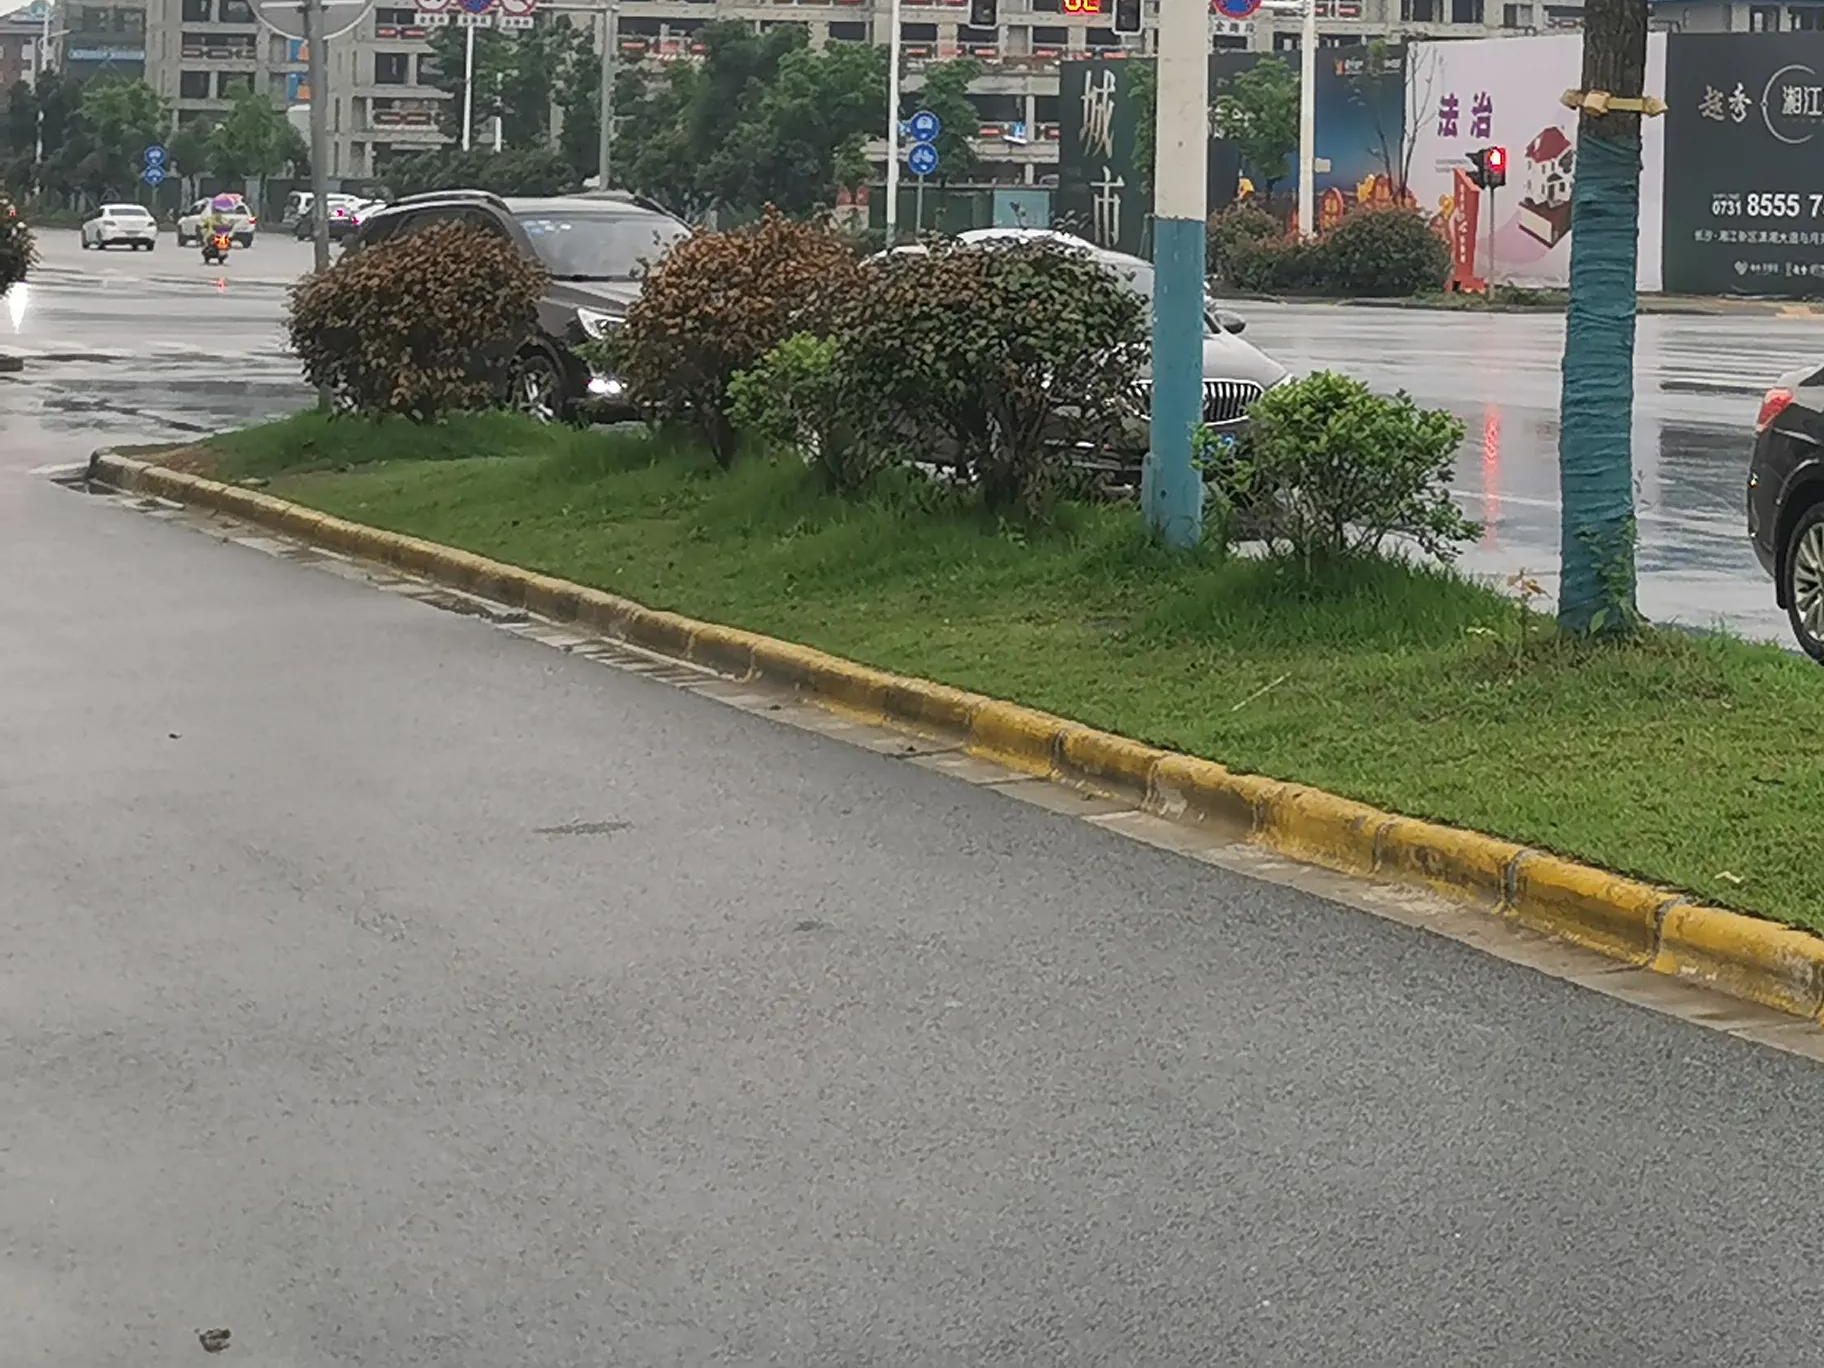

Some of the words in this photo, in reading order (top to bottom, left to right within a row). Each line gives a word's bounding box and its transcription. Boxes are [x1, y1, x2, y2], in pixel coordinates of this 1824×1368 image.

[1437, 90, 1494, 139] 法治
[1697, 82, 1753, 123] 越秀
[1711, 199, 1742, 216] 0731
[1746, 193, 1800, 218] 8555
